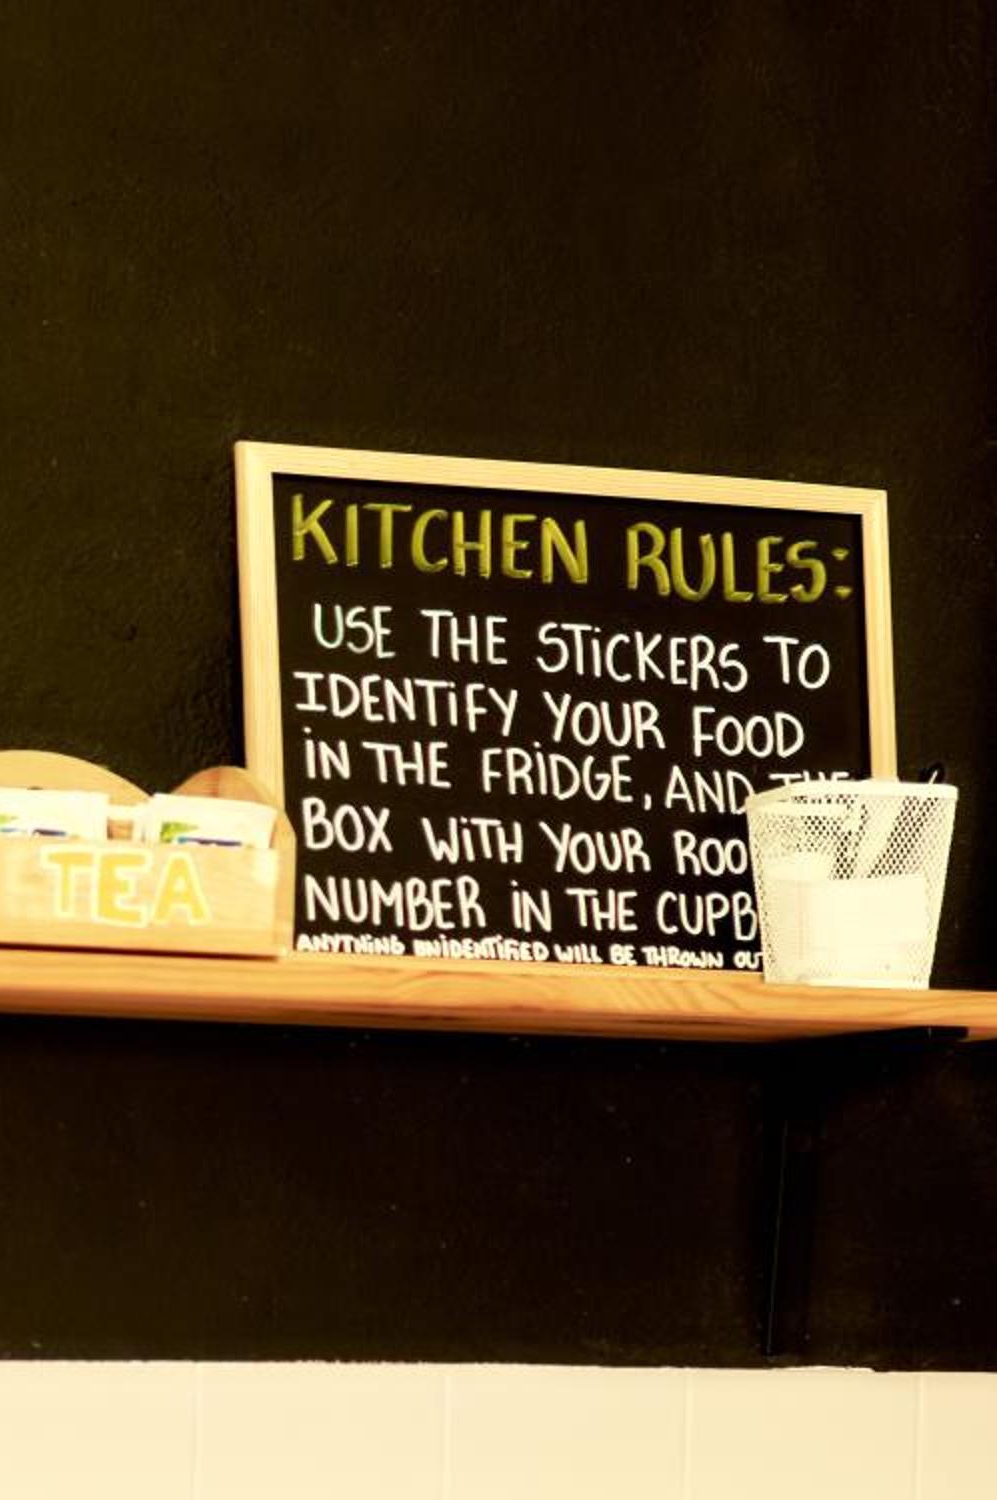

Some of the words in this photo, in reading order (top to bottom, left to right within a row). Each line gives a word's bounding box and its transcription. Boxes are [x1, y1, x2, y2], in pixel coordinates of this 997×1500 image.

[293, 494, 589, 583] KITCHEN
[627, 523, 851, 602] RULES:
[313, 603, 396, 659] USE
[420, 609, 508, 665] THE
[762, 636, 831, 690] TO
[542, 691, 666, 750] YOUR
[692, 705, 805, 759] FOOD
[361, 740, 452, 789] THE
[664, 764, 755, 815] AND
[301, 796, 393, 853] BOX
[538, 821, 652, 875] YOUR
[672, 829, 749, 877] ROO
[40, 845, 210, 928] TEA
[304, 873, 487, 932] NUMBER
[565, 887, 638, 932] THE
[656, 887, 757, 942] CUPB
[554, 943, 603, 964] WILL
[609, 943, 638, 966] BE
[641, 946, 724, 969] THROWN
